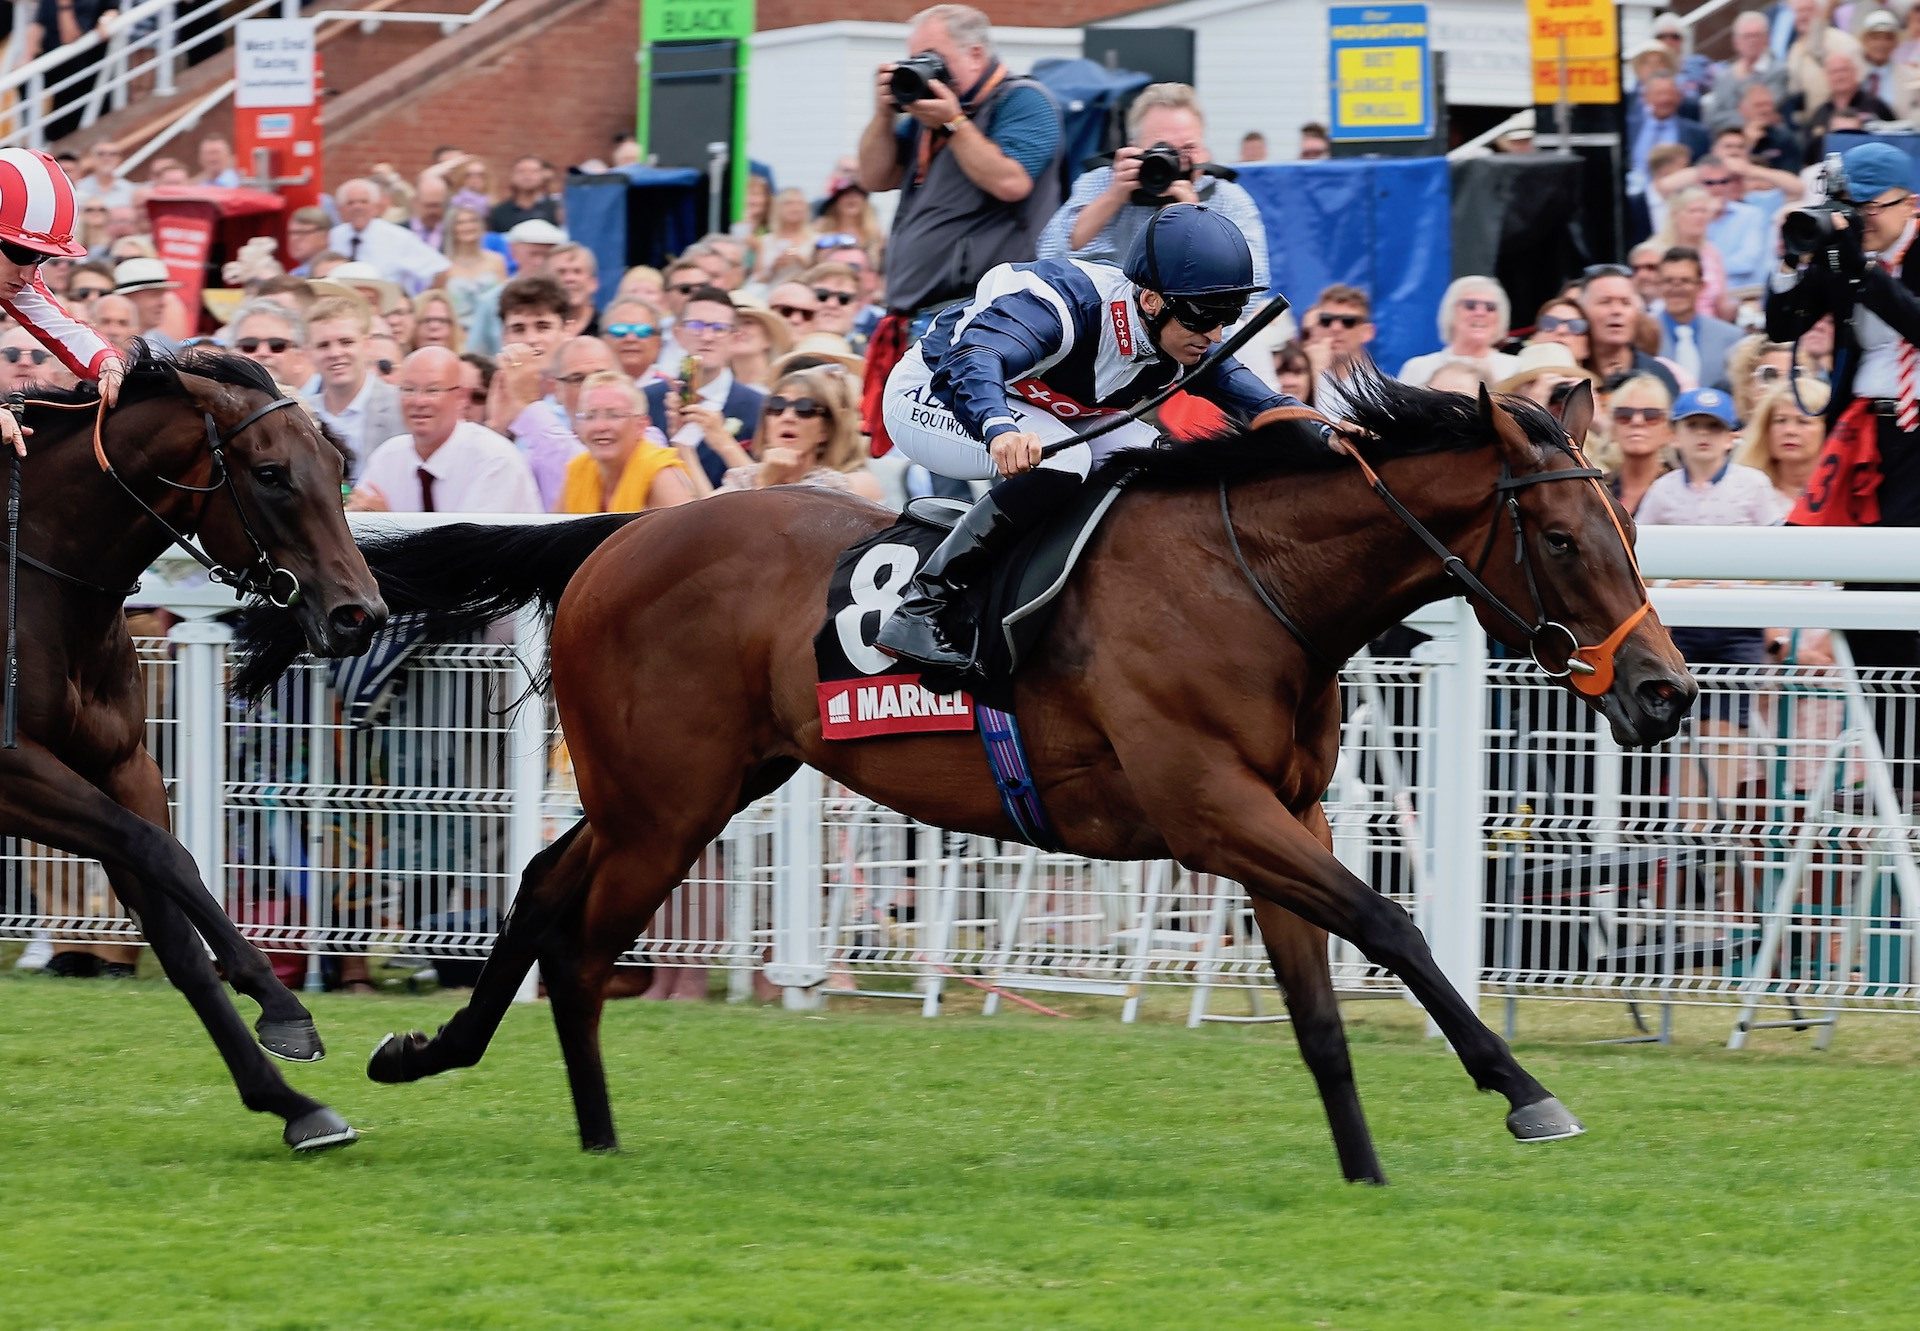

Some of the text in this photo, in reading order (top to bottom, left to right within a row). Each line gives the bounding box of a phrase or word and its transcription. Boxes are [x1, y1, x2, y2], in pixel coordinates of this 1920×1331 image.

[664, 8, 735, 33] BLACK
[1114, 307, 1129, 349] tote
[1805, 453, 1839, 513] 3
[835, 543, 920, 675] 8
[857, 684, 969, 722] MARKEL
